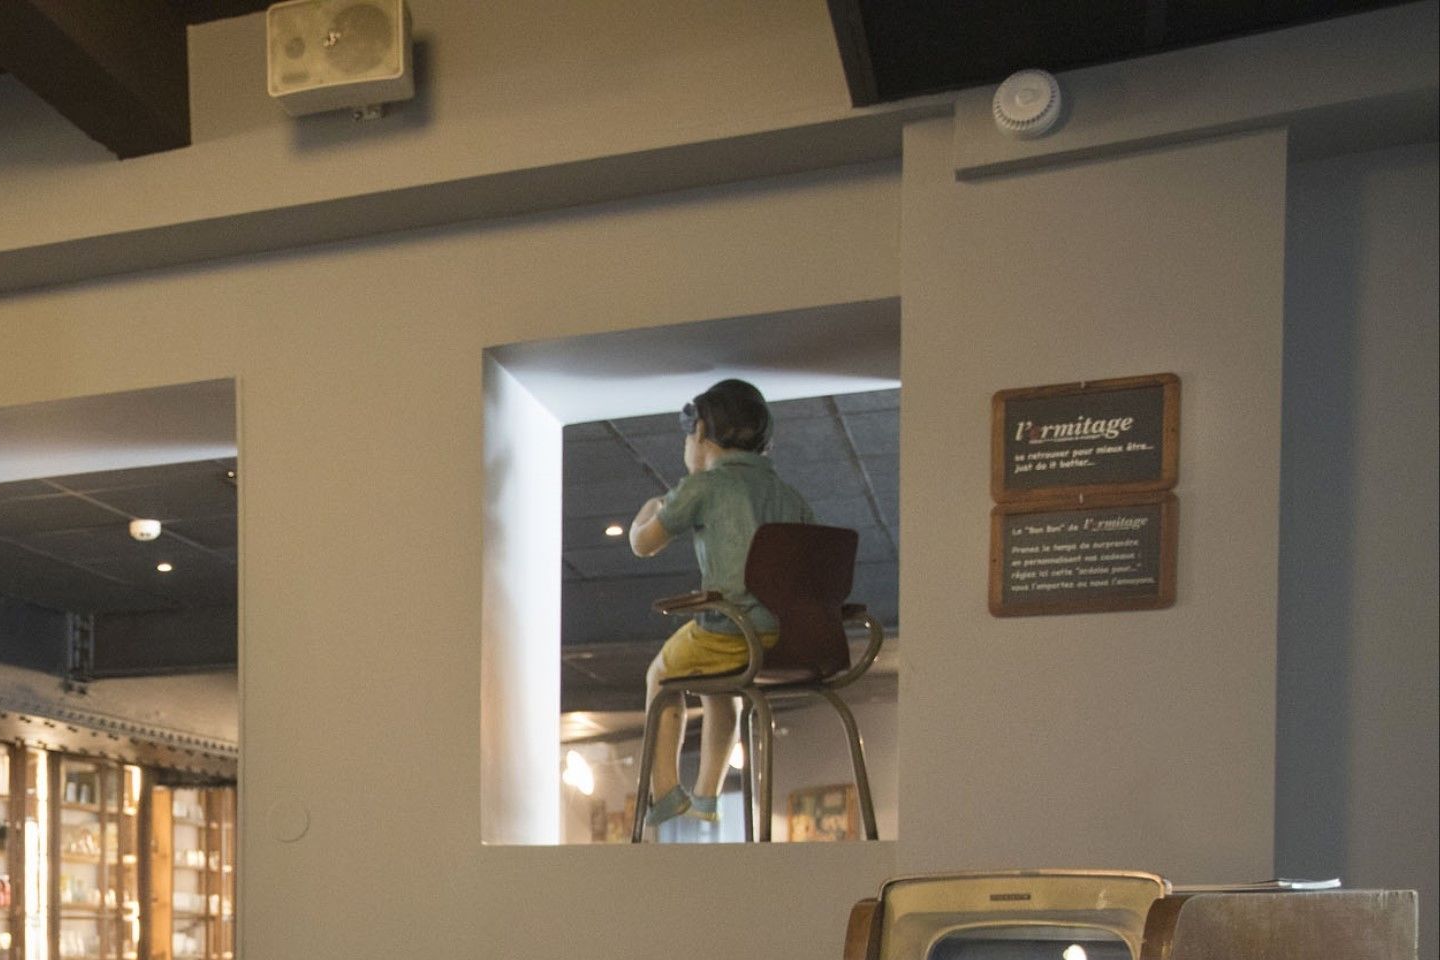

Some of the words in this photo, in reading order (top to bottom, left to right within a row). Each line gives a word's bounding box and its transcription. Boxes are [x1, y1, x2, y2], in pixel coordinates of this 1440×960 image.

[1015, 415, 1134, 441] l'rmitage
[1014, 464, 1033, 474] just
[1083, 517, 1148, 531] l'rmitage
